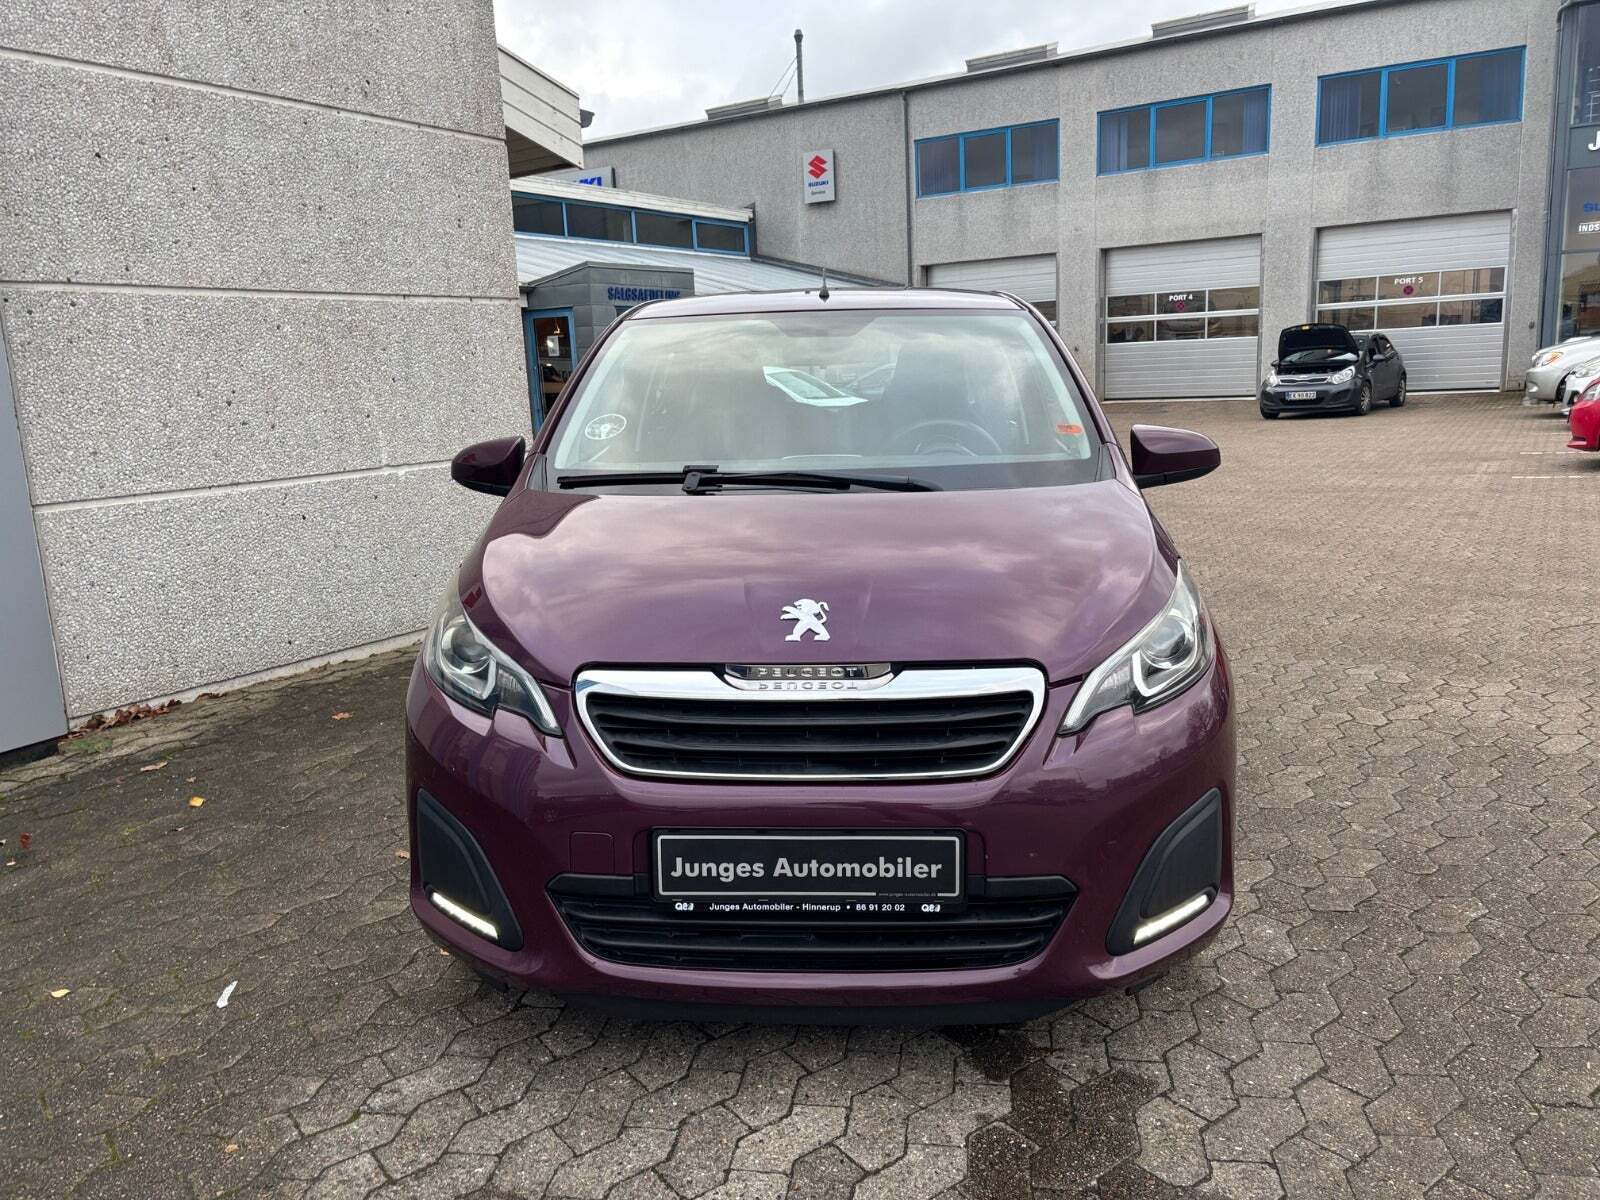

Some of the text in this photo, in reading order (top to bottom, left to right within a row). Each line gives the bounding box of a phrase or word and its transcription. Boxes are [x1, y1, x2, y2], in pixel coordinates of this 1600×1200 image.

[1394, 277, 1416, 285] PORT
[1168, 294, 1187, 302] PORT
[758, 667, 857, 677] PEUGEOT
[670, 856, 943, 883] Junges Automobiler
[709, 902, 740, 912] Junges
[742, 902, 794, 911] Automobiler
[802, 903, 841, 912] Hinnerup
[855, 903, 866, 911] 86
[868, 903, 878, 911] 91
[881, 903, 892, 911] 20
[894, 903, 905, 911] 02
